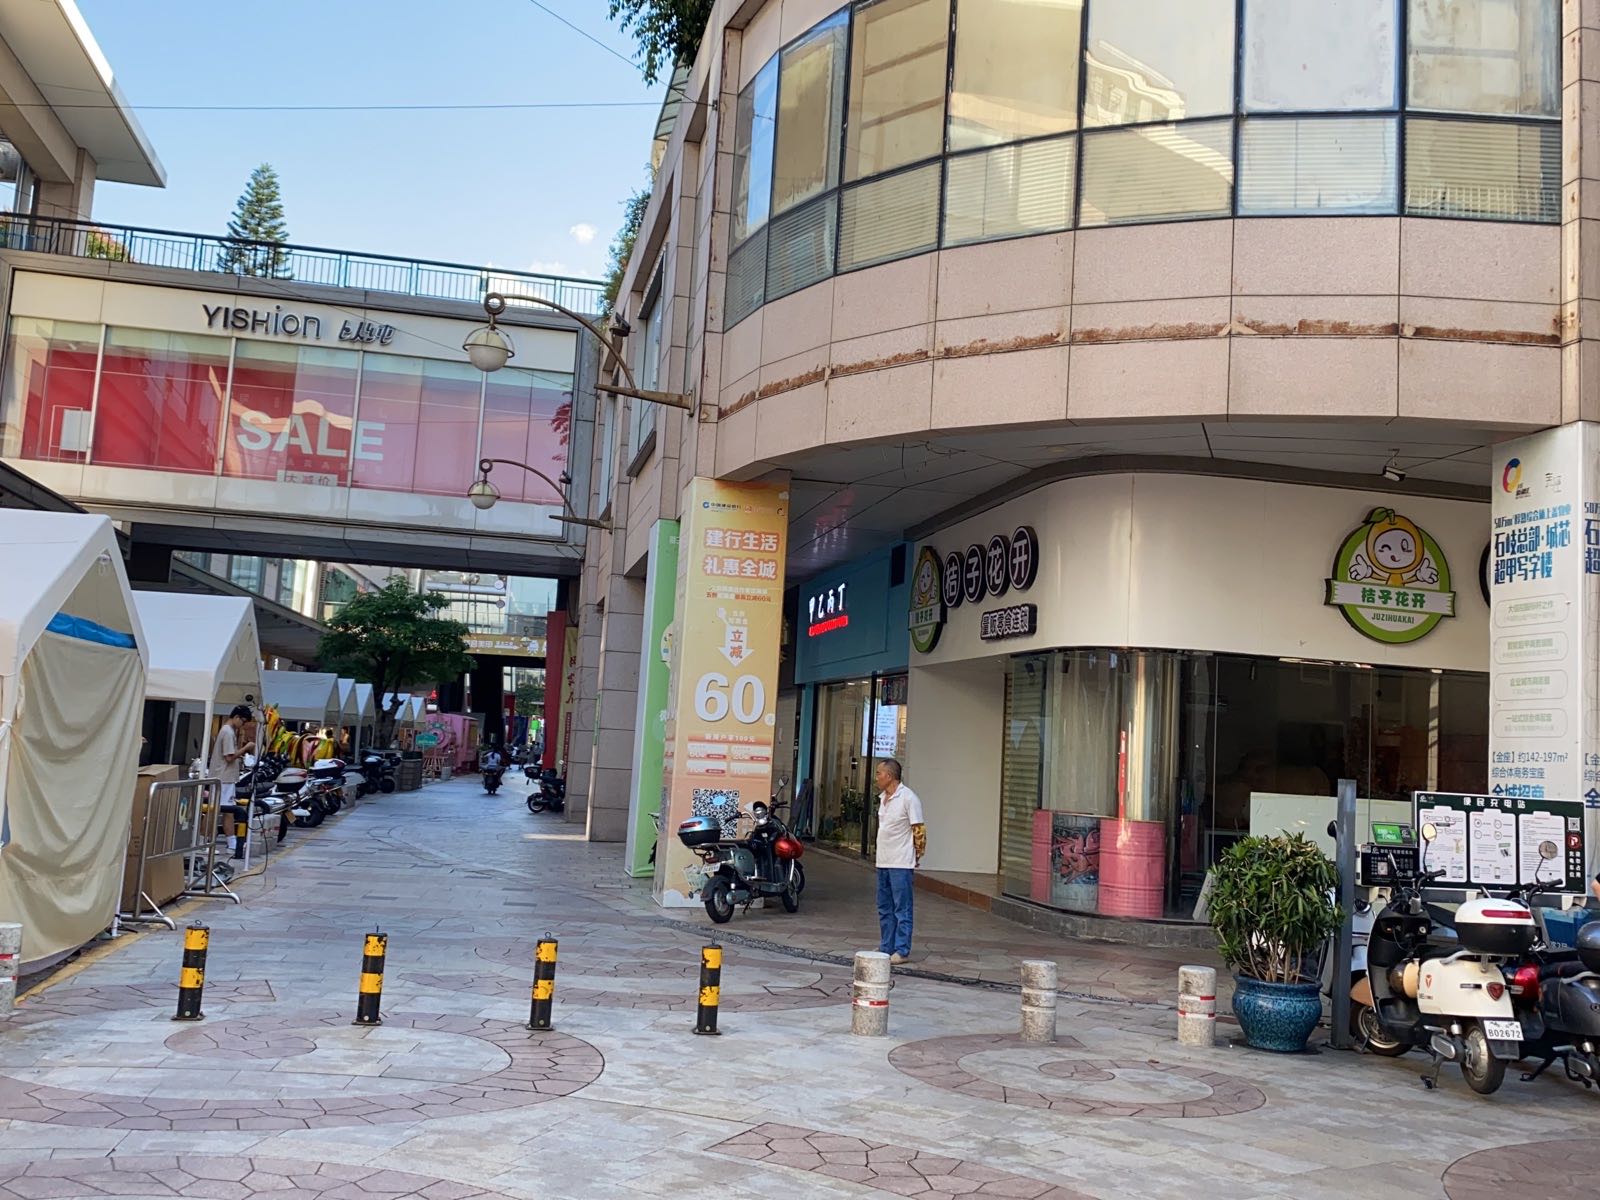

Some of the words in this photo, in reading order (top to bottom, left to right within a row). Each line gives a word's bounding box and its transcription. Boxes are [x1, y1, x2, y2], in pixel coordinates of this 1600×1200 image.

[236, 410, 385, 461] SALE
[705, 529, 778, 551] 建行生活
[704, 557, 776, 579] 礼惠全城
[944, 537, 1030, 599] 桔子花开
[1494, 551, 1553, 585] 超甲写字楼
[1361, 587, 1426, 609] 桔子花开
[730, 629, 744, 659] 立减
[694, 671, 766, 724] 60
[1463, 797, 1526, 809] 便民充电站
[1488, 1028, 1521, 1039] B02672
